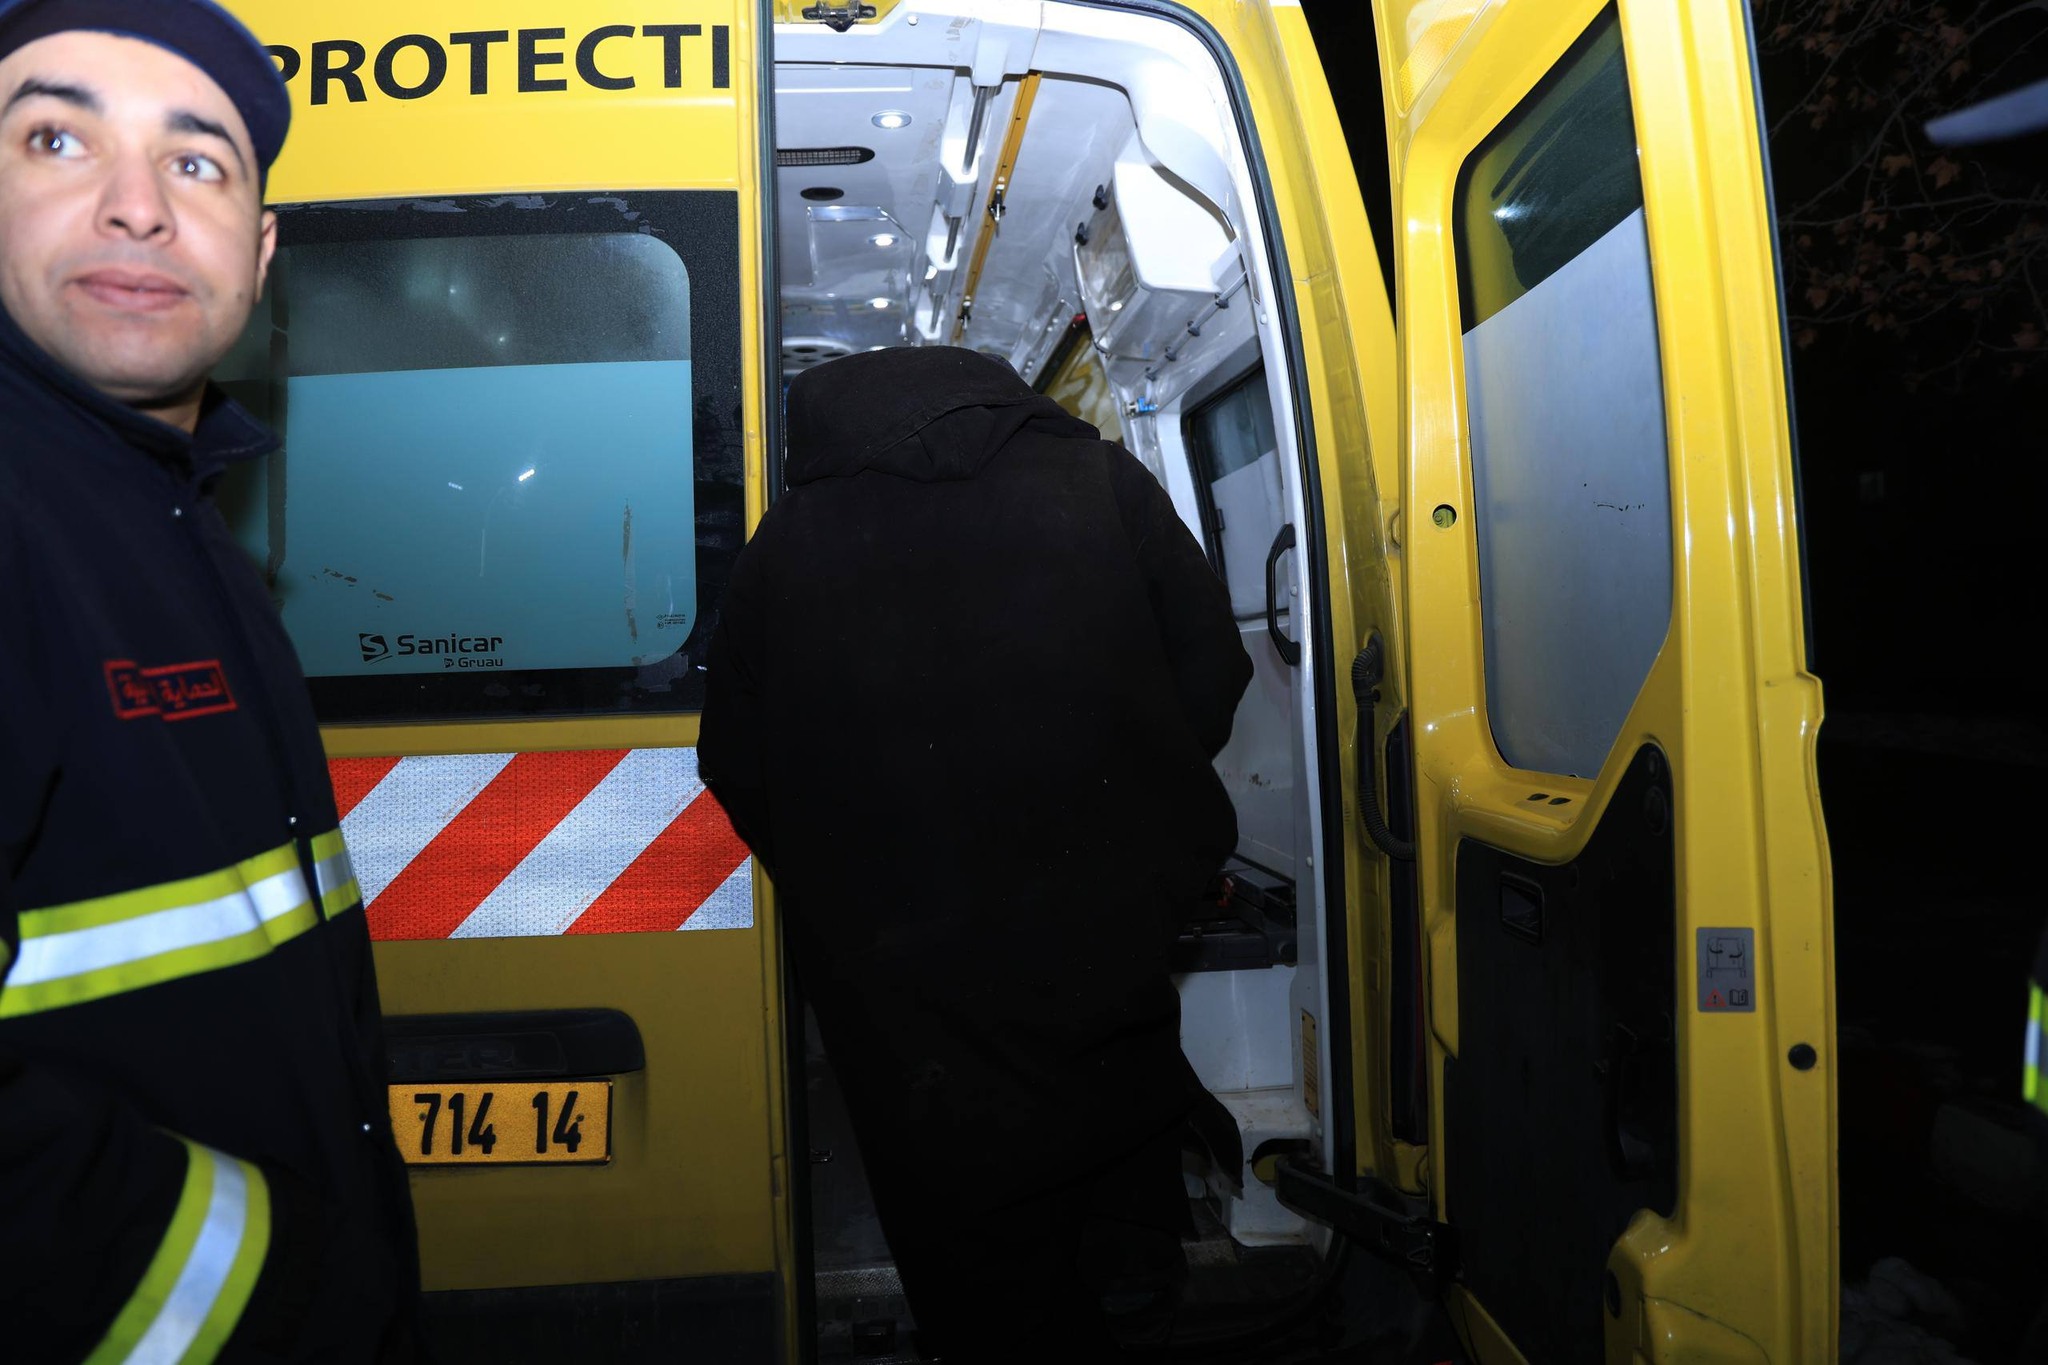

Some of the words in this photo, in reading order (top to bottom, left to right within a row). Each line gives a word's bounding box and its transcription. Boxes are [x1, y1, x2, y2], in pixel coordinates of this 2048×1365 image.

[397, 633, 503, 655] Sanicar
[458, 657, 503, 668] Gruau
[414, 1092, 496, 1155] 714
[532, 1091, 582, 1153] 14
